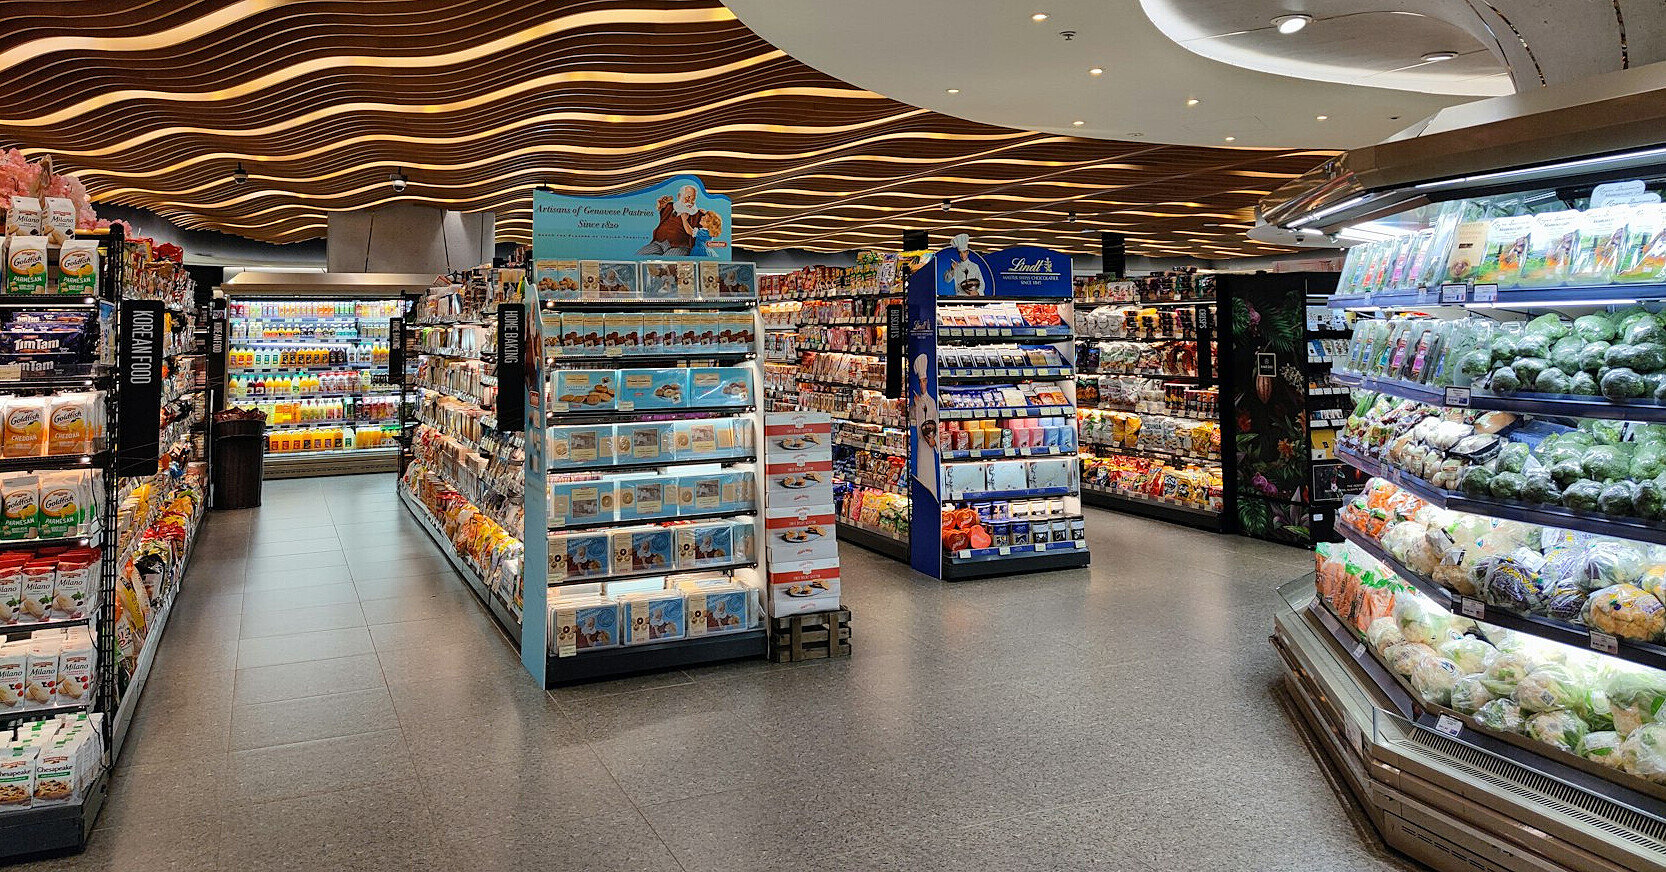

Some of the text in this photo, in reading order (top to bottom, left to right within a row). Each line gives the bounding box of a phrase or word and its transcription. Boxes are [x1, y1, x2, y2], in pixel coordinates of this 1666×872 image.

[536, 204, 655, 217] Artisans of Genovese Pastries
[16, 215, 40, 223] Milano
[51, 215, 74, 223] Milano
[577, 220, 619, 228] Since 1820
[13, 255, 42, 267] Goldfish
[64, 256, 91, 267] Goldfish
[1008, 257, 1044, 272] Lindt
[890, 309, 900, 338] BISCUITS
[1198, 308, 1207, 329] CRISPS
[504, 310, 519, 364] HOME BAKING
[130, 310, 154, 384] KOREAN FOOD
[11, 412, 40, 425] Goldfish
[54, 411, 82, 423] Goldfish
[11, 433, 37, 442] CHEDDAR
[55, 431, 80, 439] CHEDDAR
[6, 496, 33, 509] Goldfish
[45, 495, 74, 508] Goldfish
[5, 518, 35, 526] PARMESAN
[45, 516, 74, 524] PARMESAN
[58, 579, 83, 587] Milano
[29, 668, 56, 676] Milano
[63, 663, 89, 671] Milano
[0, 769, 31, 777] hesapeake
[37, 765, 73, 773] Chesapeake
